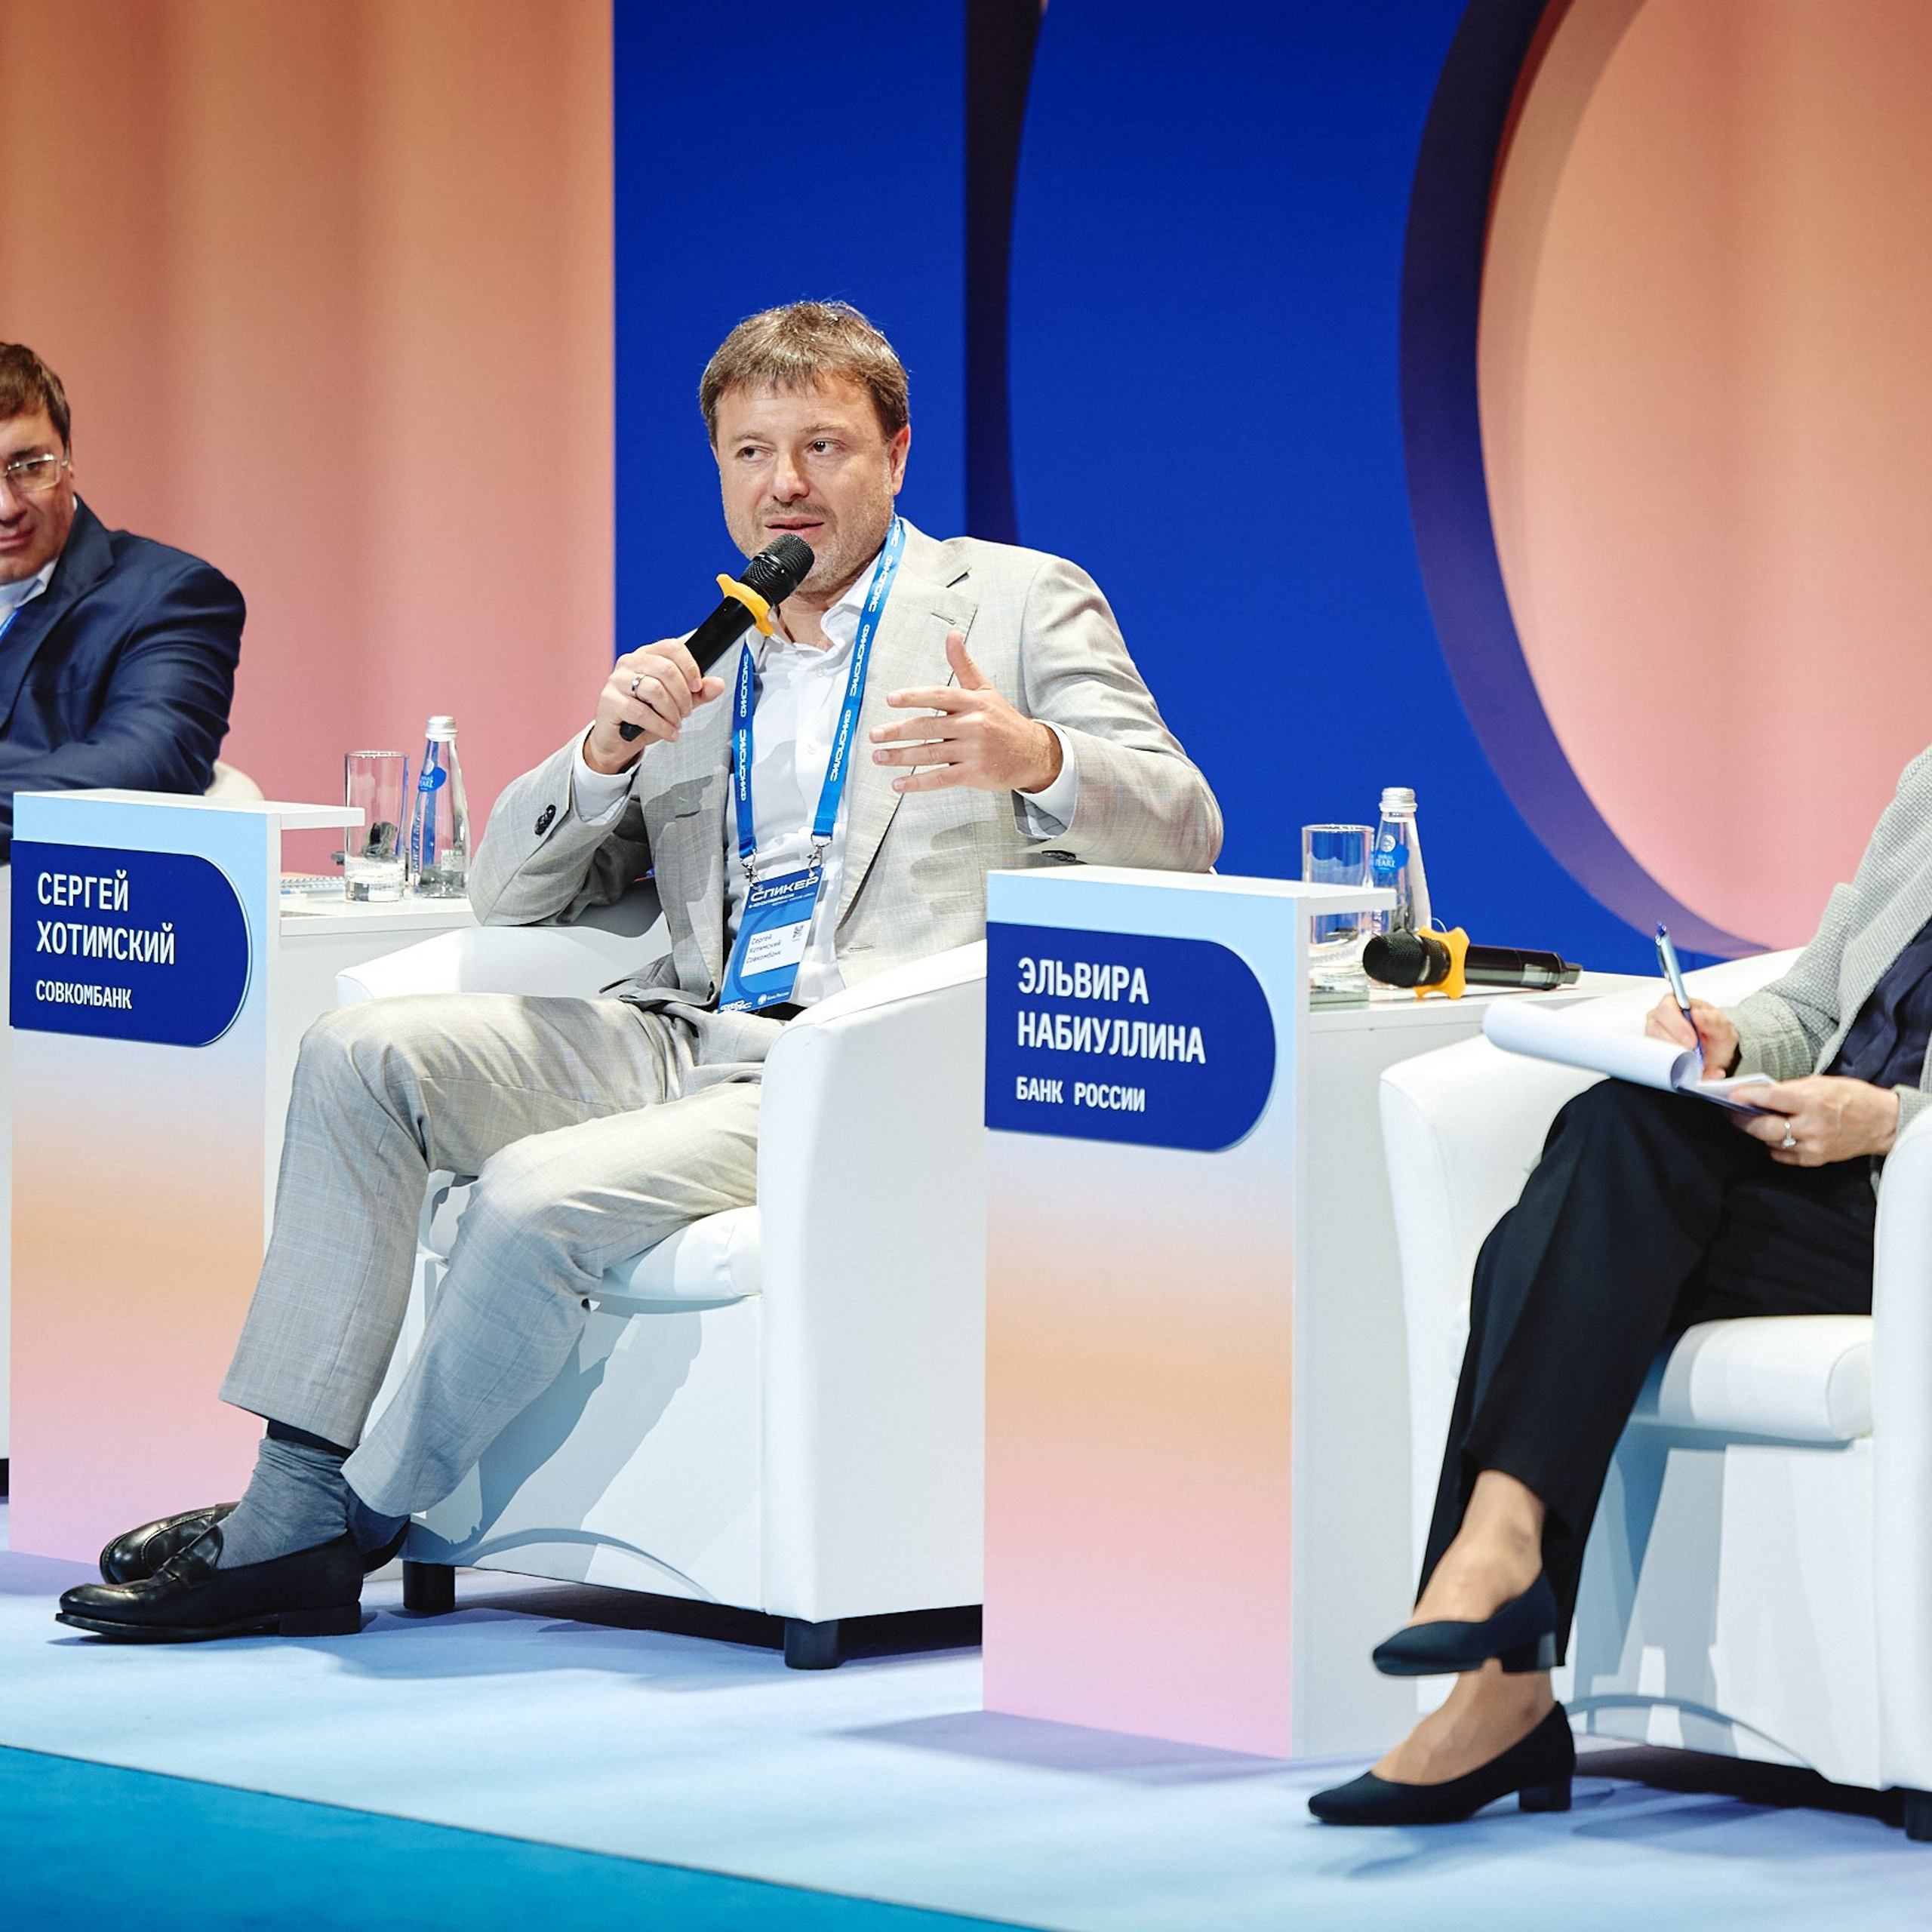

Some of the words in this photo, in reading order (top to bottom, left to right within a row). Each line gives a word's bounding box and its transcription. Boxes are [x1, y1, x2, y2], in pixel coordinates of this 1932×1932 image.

[849, 623, 871, 697] ФИНОПОЛИС
[740, 654, 749, 718] ФИНОПОЛИС
[739, 728, 747, 801] ФИНОПОЛИС
[829, 709, 852, 782] ФИНОПОЛИС
[37, 869, 129, 912] СЕРГЕЙ
[750, 876, 820, 903] СПИКЕР
[36, 921, 175, 965] ХОТИМСКИЙ
[35, 980, 133, 1010] СОВКОМБАНК
[1017, 957, 1149, 1004] ЭЛЬВИРА
[1017, 1011, 1207, 1065] НАБИУЛЛИНА
[1016, 1076, 1064, 1104] БАНК
[1073, 1081, 1146, 1112] РОССИИ
